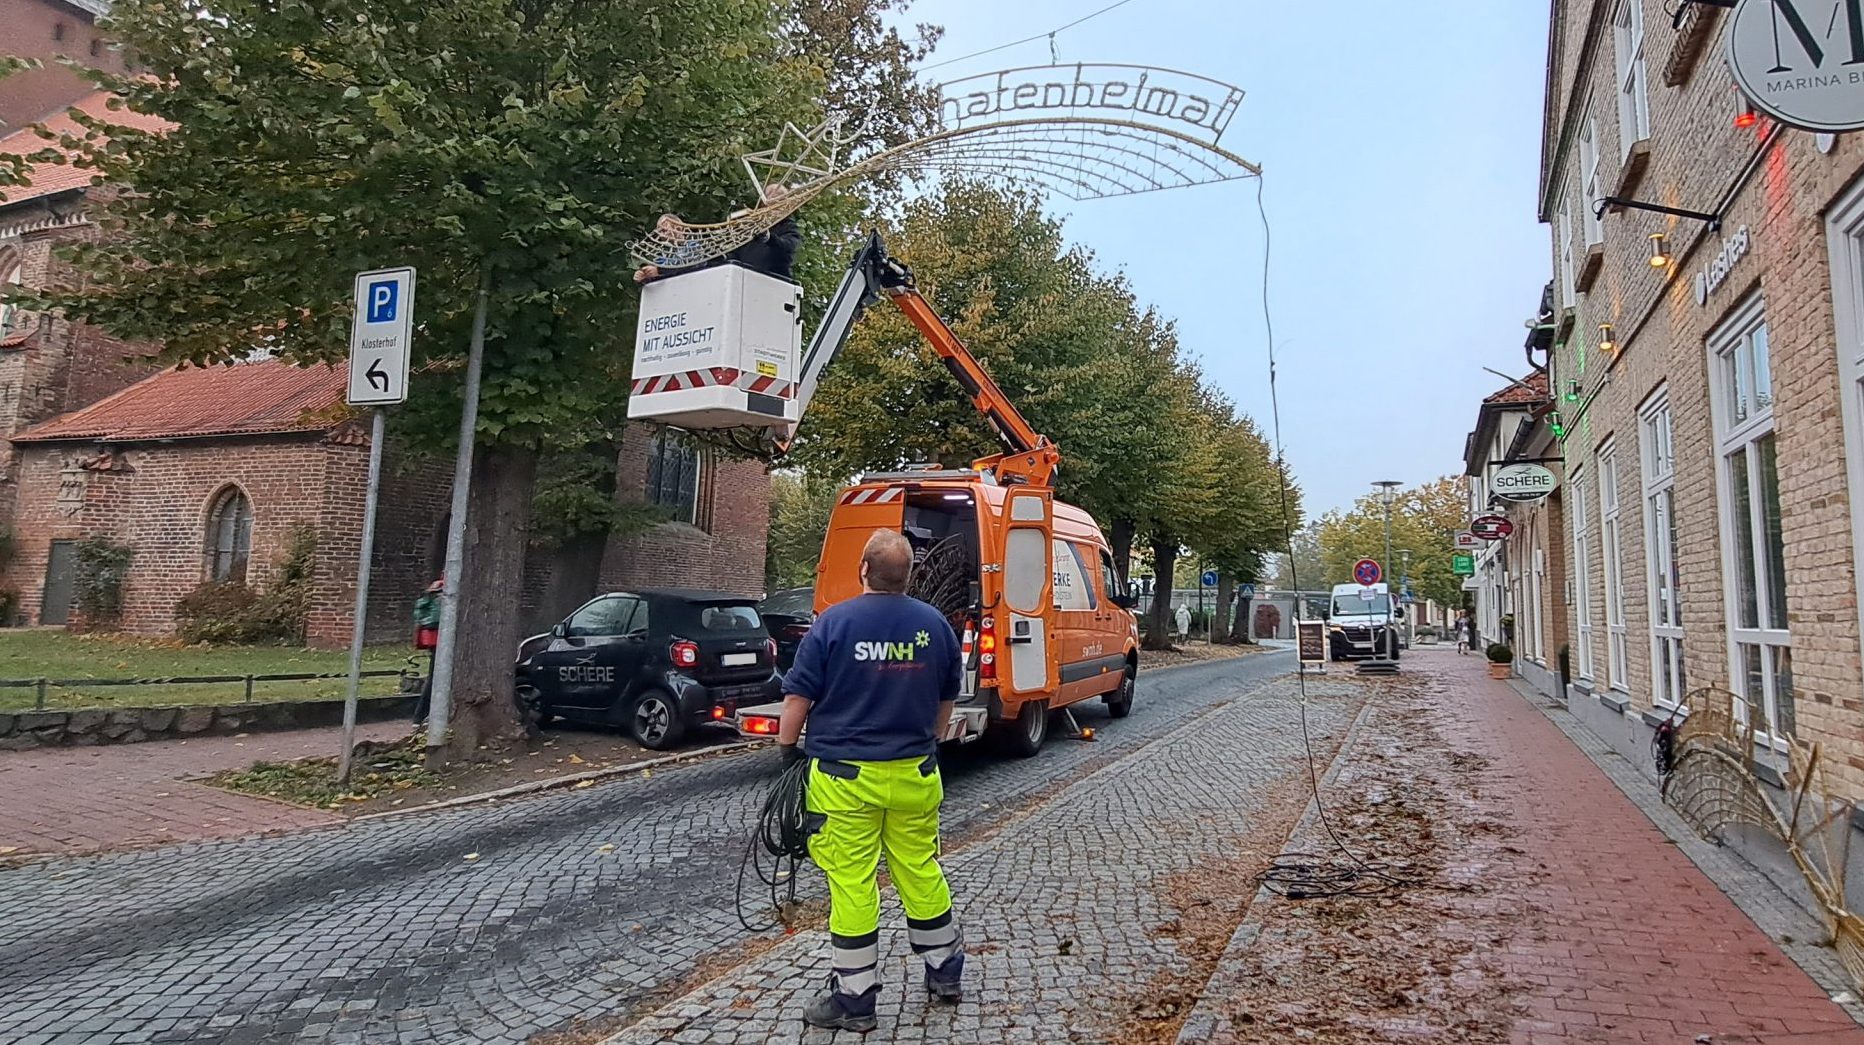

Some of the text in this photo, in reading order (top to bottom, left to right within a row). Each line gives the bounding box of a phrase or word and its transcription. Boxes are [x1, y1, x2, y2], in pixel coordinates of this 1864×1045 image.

[1766, 0, 1864, 74] M
[1767, 70, 1864, 93] MARINA B
[1704, 224, 1748, 294] Lashes
[374, 286, 391, 318] P
[644, 312, 687, 333] ENERGIE
[361, 336, 398, 350] Klosterhof
[643, 327, 714, 352] MIT AUSSICHT
[1496, 475, 1550, 488] SCHERE
[854, 640, 914, 661] SWNH
[559, 666, 615, 682] SCHERE
